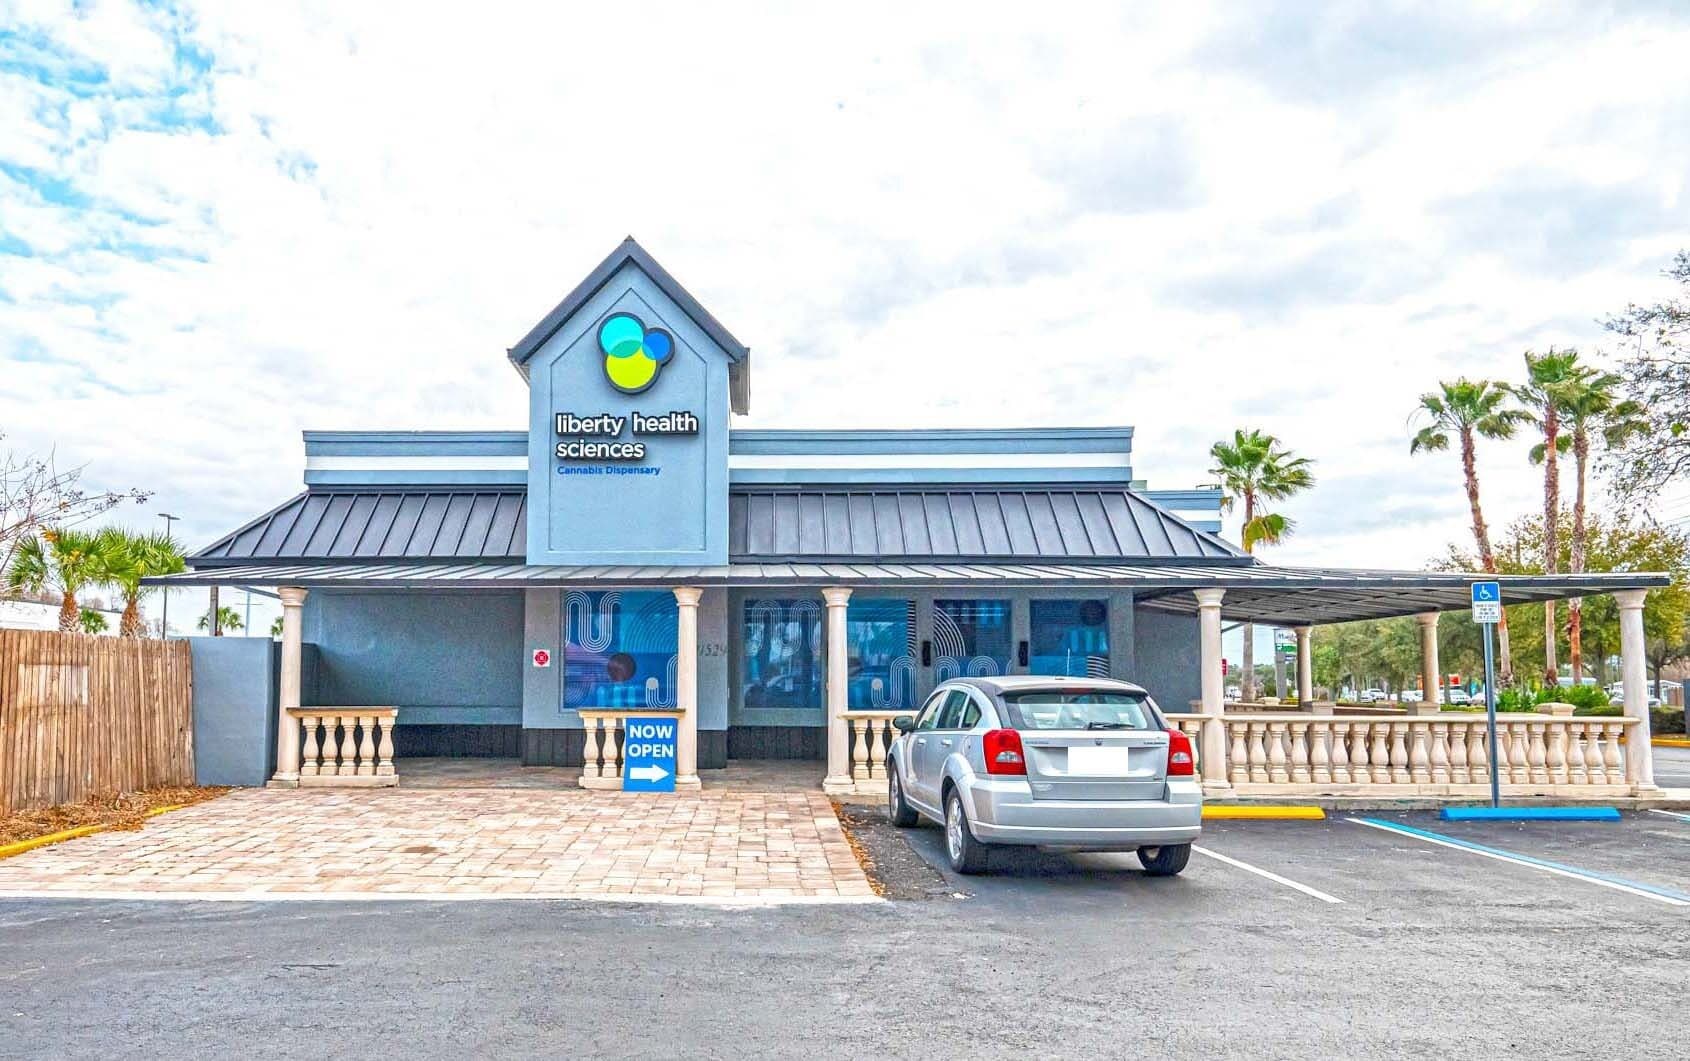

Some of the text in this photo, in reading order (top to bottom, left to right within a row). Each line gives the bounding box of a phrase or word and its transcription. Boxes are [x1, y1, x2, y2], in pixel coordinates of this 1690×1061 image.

[556, 412, 698, 436] liberty health
[556, 439, 645, 458] sciences
[557, 466, 661, 476] Cannabis Dispensary
[629, 725, 673, 739] NOW
[628, 743, 674, 758] OPEN
